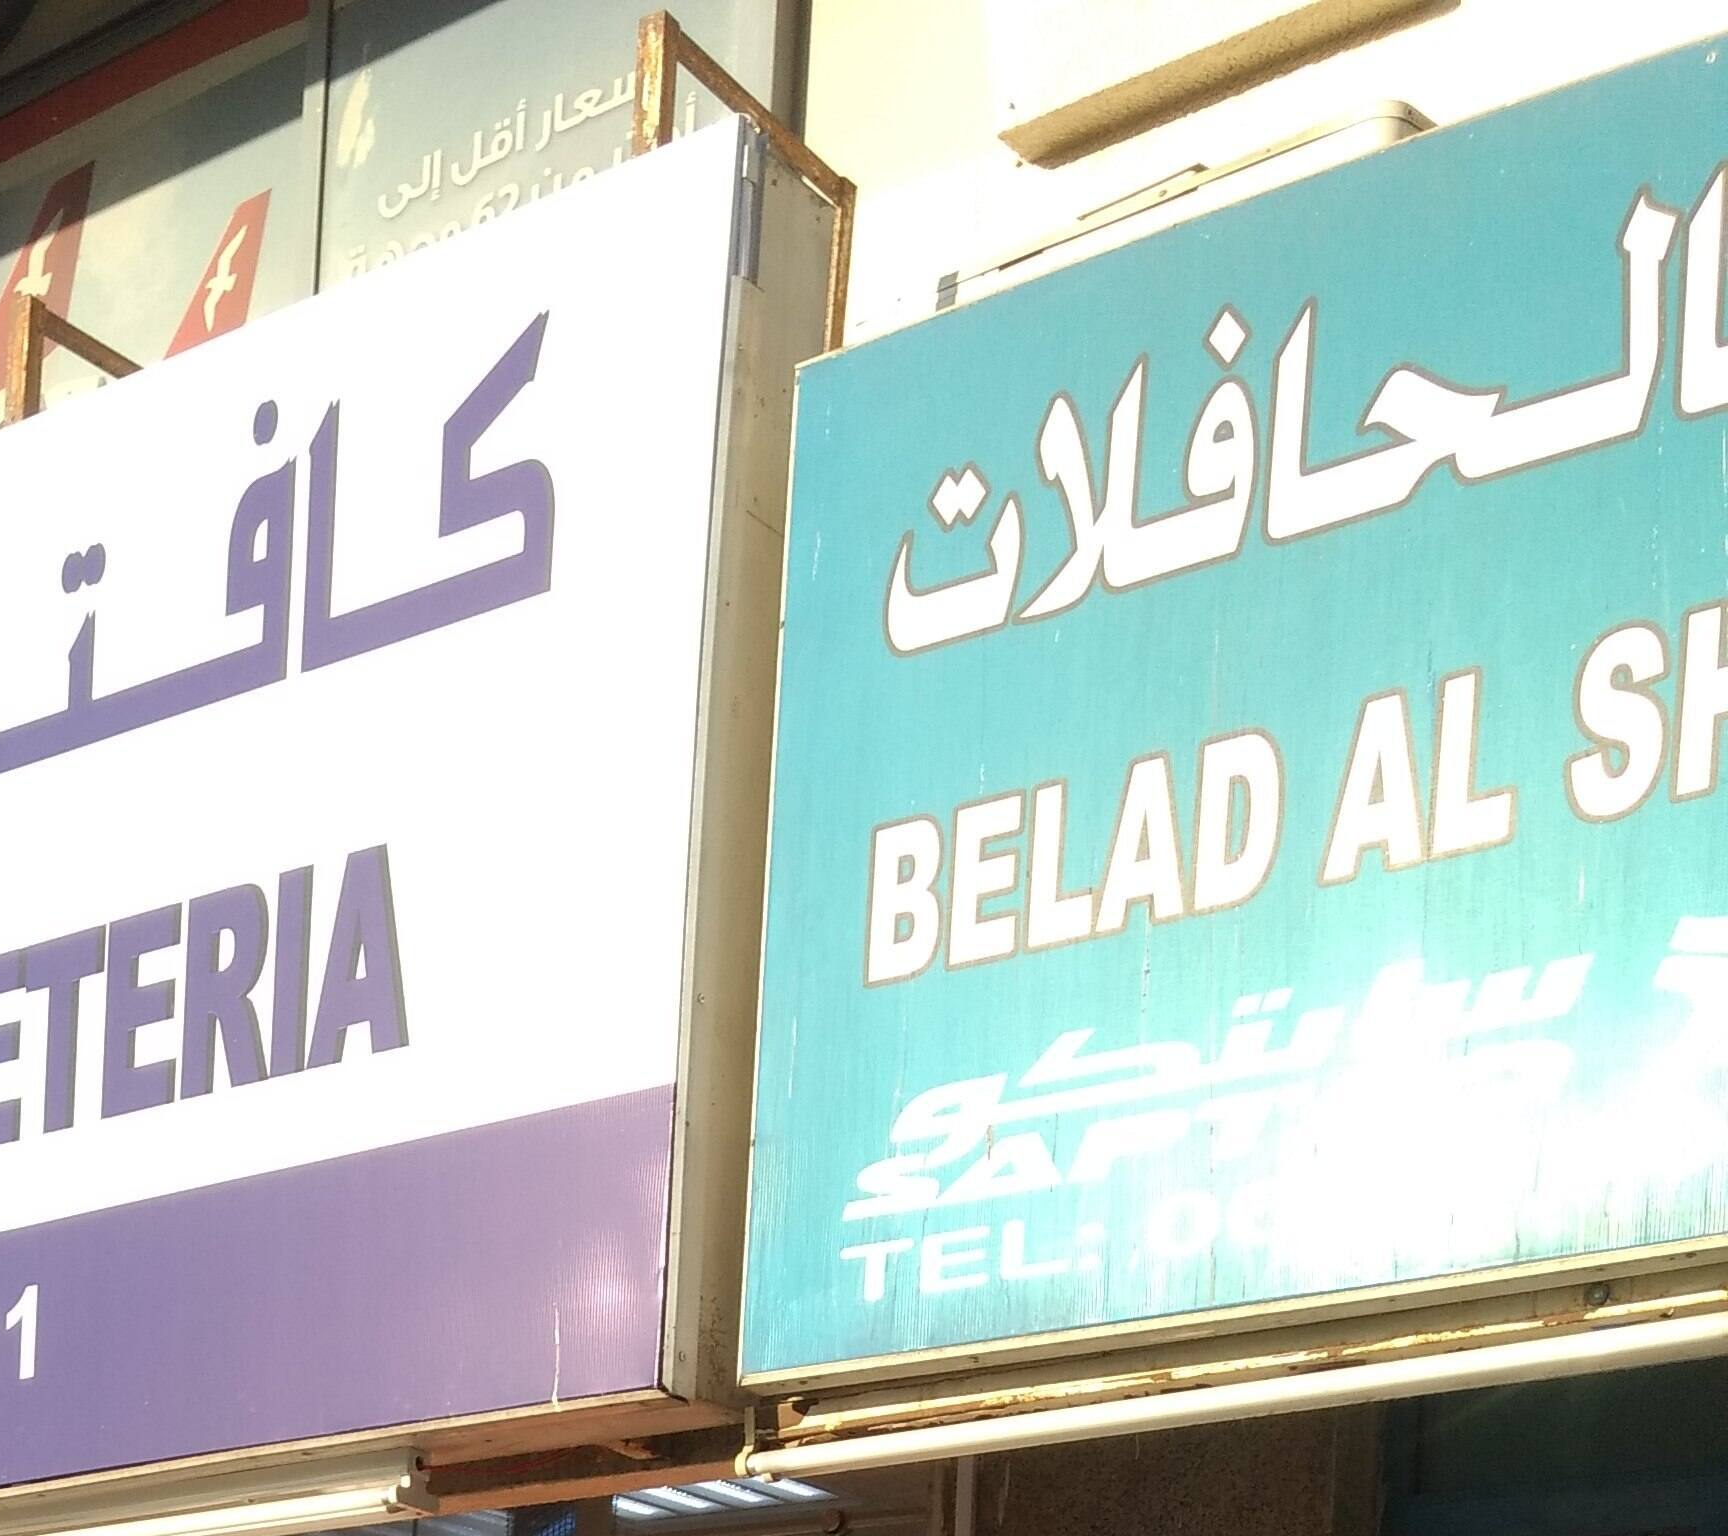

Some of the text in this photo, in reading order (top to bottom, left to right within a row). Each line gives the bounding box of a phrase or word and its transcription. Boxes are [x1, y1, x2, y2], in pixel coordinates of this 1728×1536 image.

[450, 98, 527, 186] أقل
[535, 71, 638, 152] سعار
[377, 149, 442, 219] إلى
[883, 158, 1728, 657] الحافلات
[863, 728, 1285, 988] BELAD
[1315, 665, 1517, 889] AL
